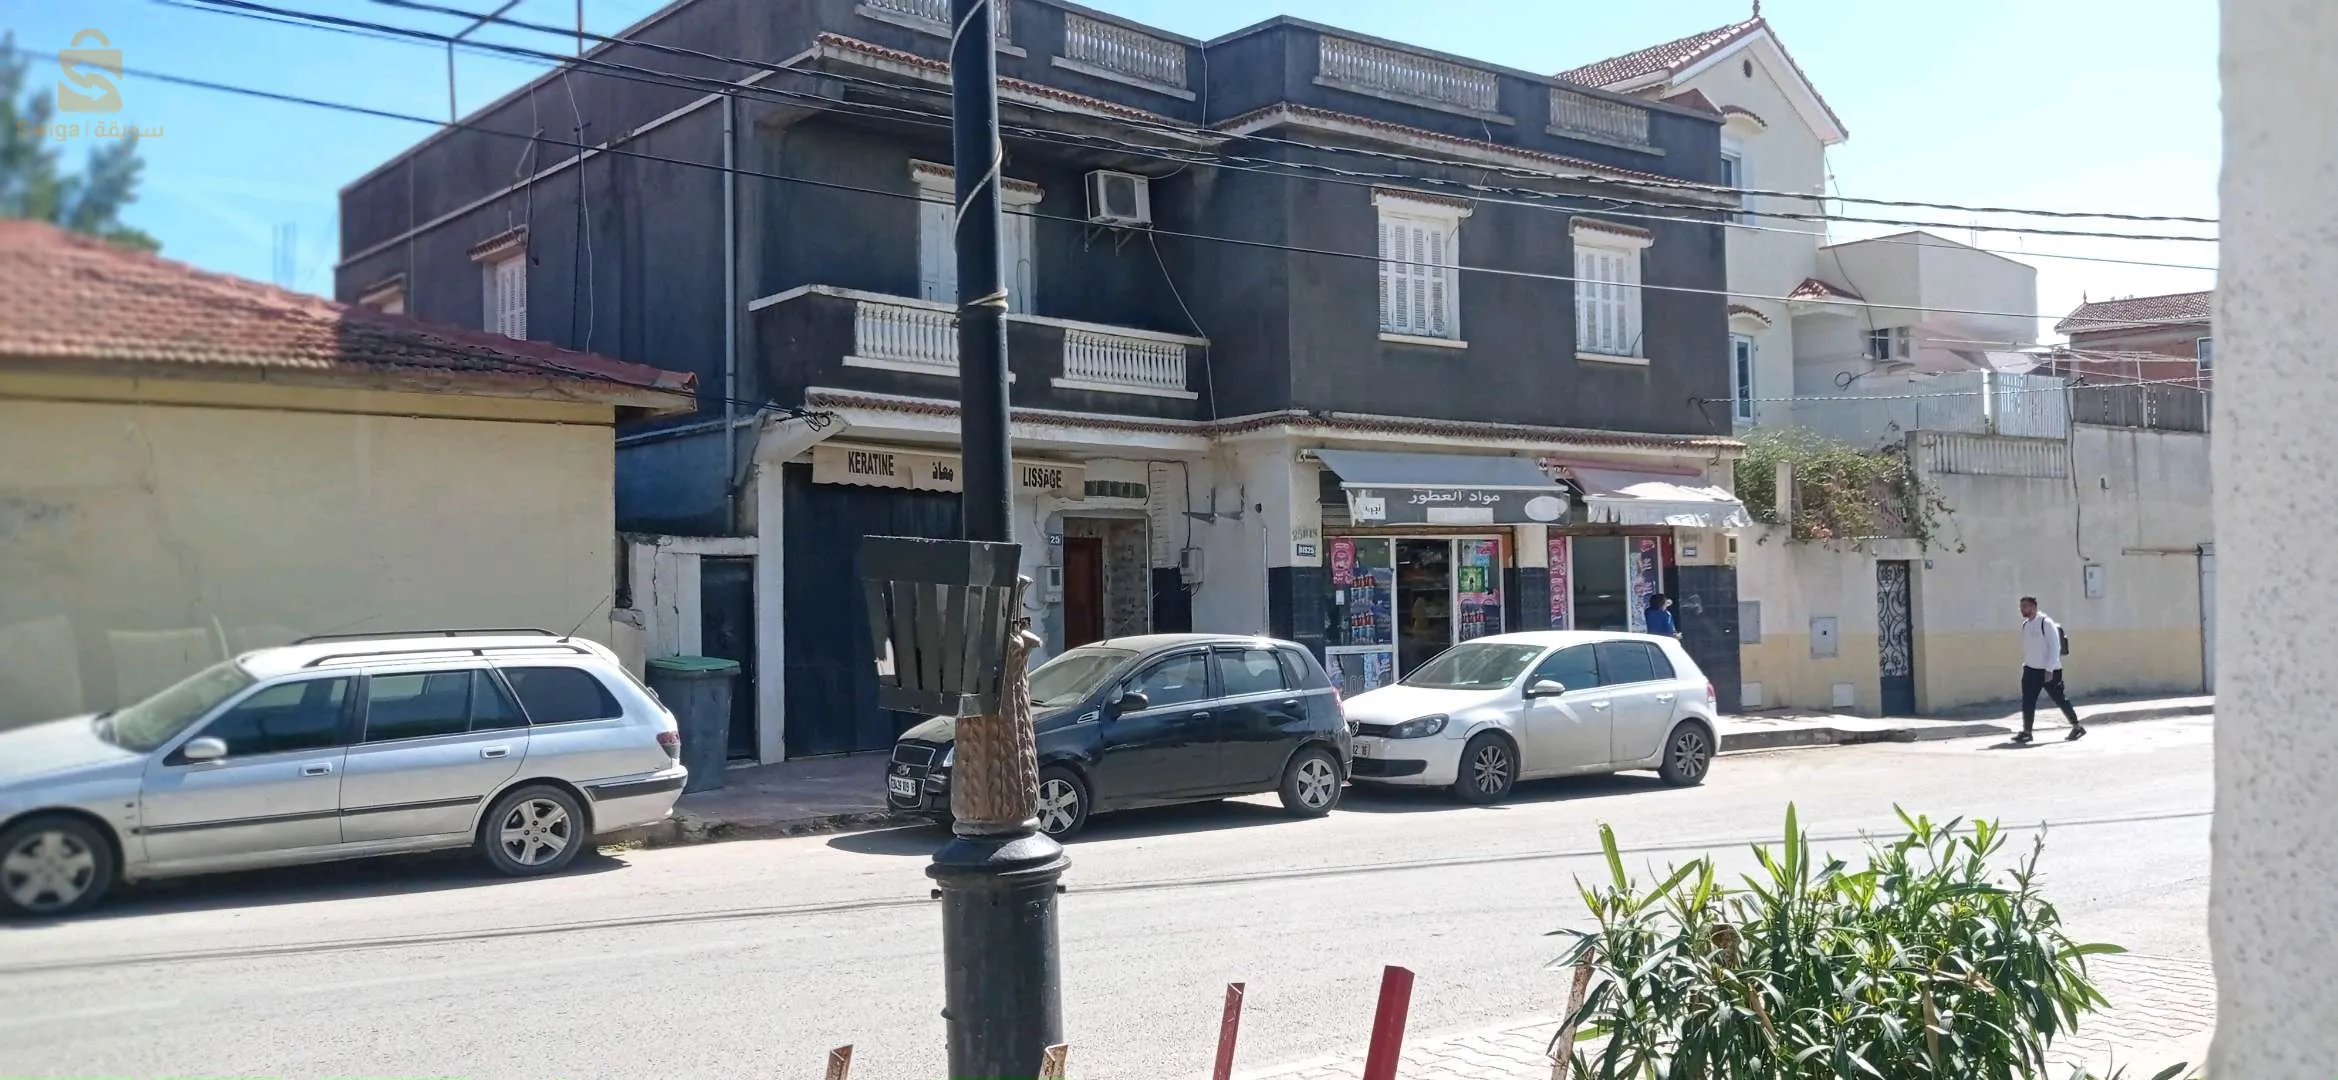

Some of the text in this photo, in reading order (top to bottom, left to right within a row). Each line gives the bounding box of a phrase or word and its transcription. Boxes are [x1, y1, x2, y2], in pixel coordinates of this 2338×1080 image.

[848, 451, 895, 476] KERATINE
[1408, 489, 1500, 505] مواد العطور
